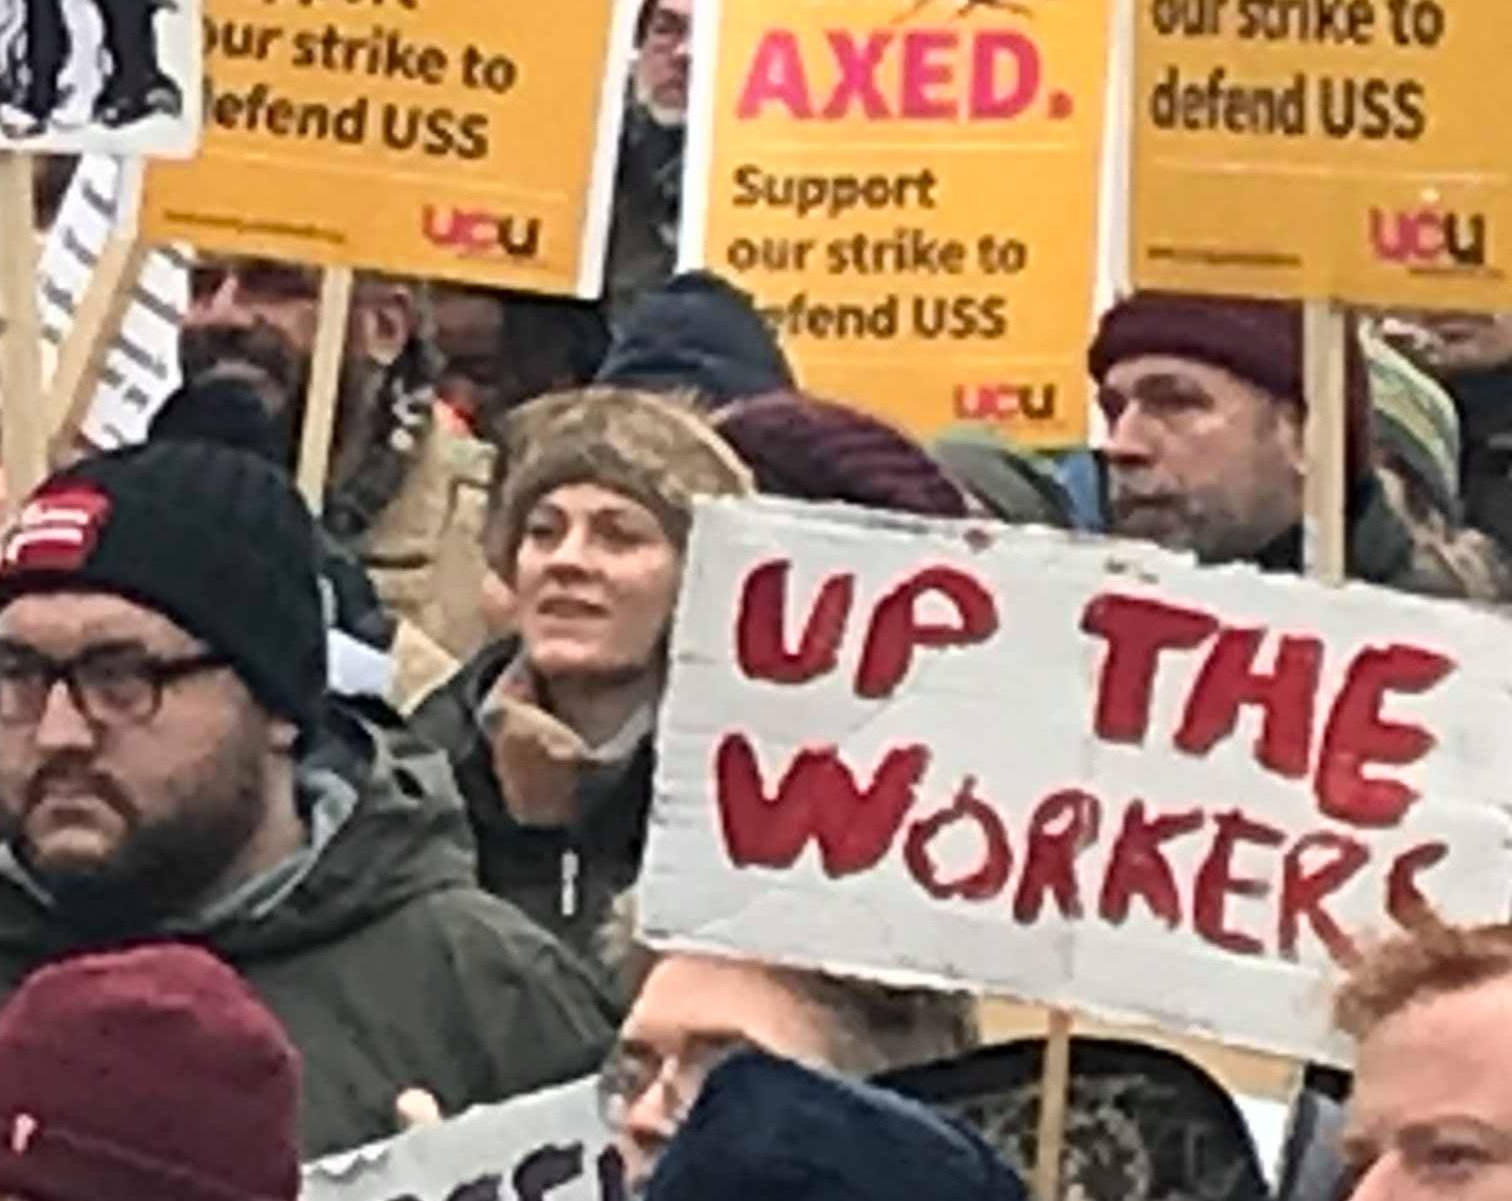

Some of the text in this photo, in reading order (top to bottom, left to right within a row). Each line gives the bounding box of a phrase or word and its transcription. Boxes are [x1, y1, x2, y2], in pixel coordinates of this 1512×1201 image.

[291, 19, 448, 86] strike
[460, 44, 518, 96] to
[736, 28, 1075, 122] AXED.
[383, 102, 490, 162] USS
[1150, 65, 1426, 141] defend USS
[732, 165, 938, 218] Support
[726, 233, 1029, 276] our strike to
[1369, 207, 1486, 265] ucu
[912, 295, 1008, 341] USS
[735, 557, 1457, 829] UP THE
